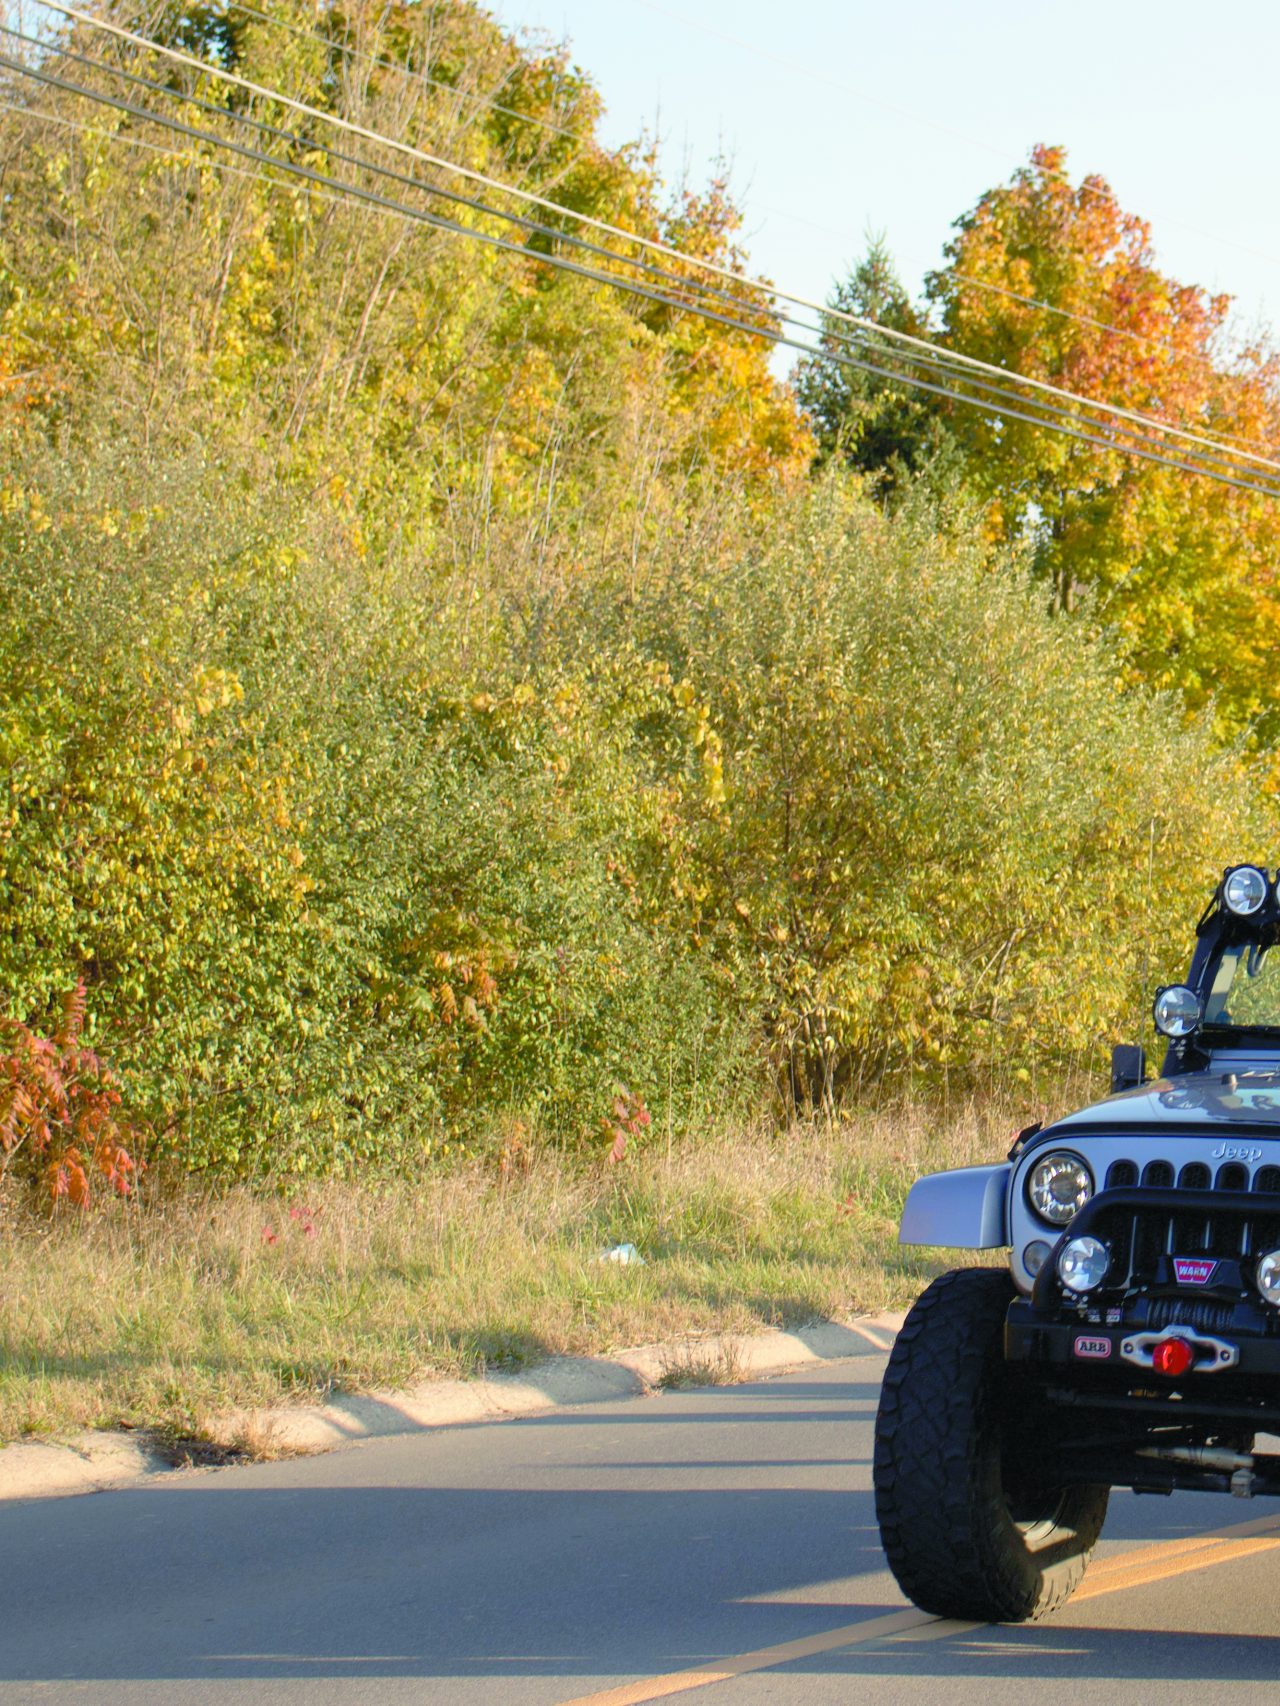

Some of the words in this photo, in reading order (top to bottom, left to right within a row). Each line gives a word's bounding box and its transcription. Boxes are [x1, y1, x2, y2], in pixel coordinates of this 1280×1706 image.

[1211, 1141, 1263, 1164] Jeep
[1178, 1265, 1208, 1277] WARN
[1079, 1341, 1106, 1352] ARB
